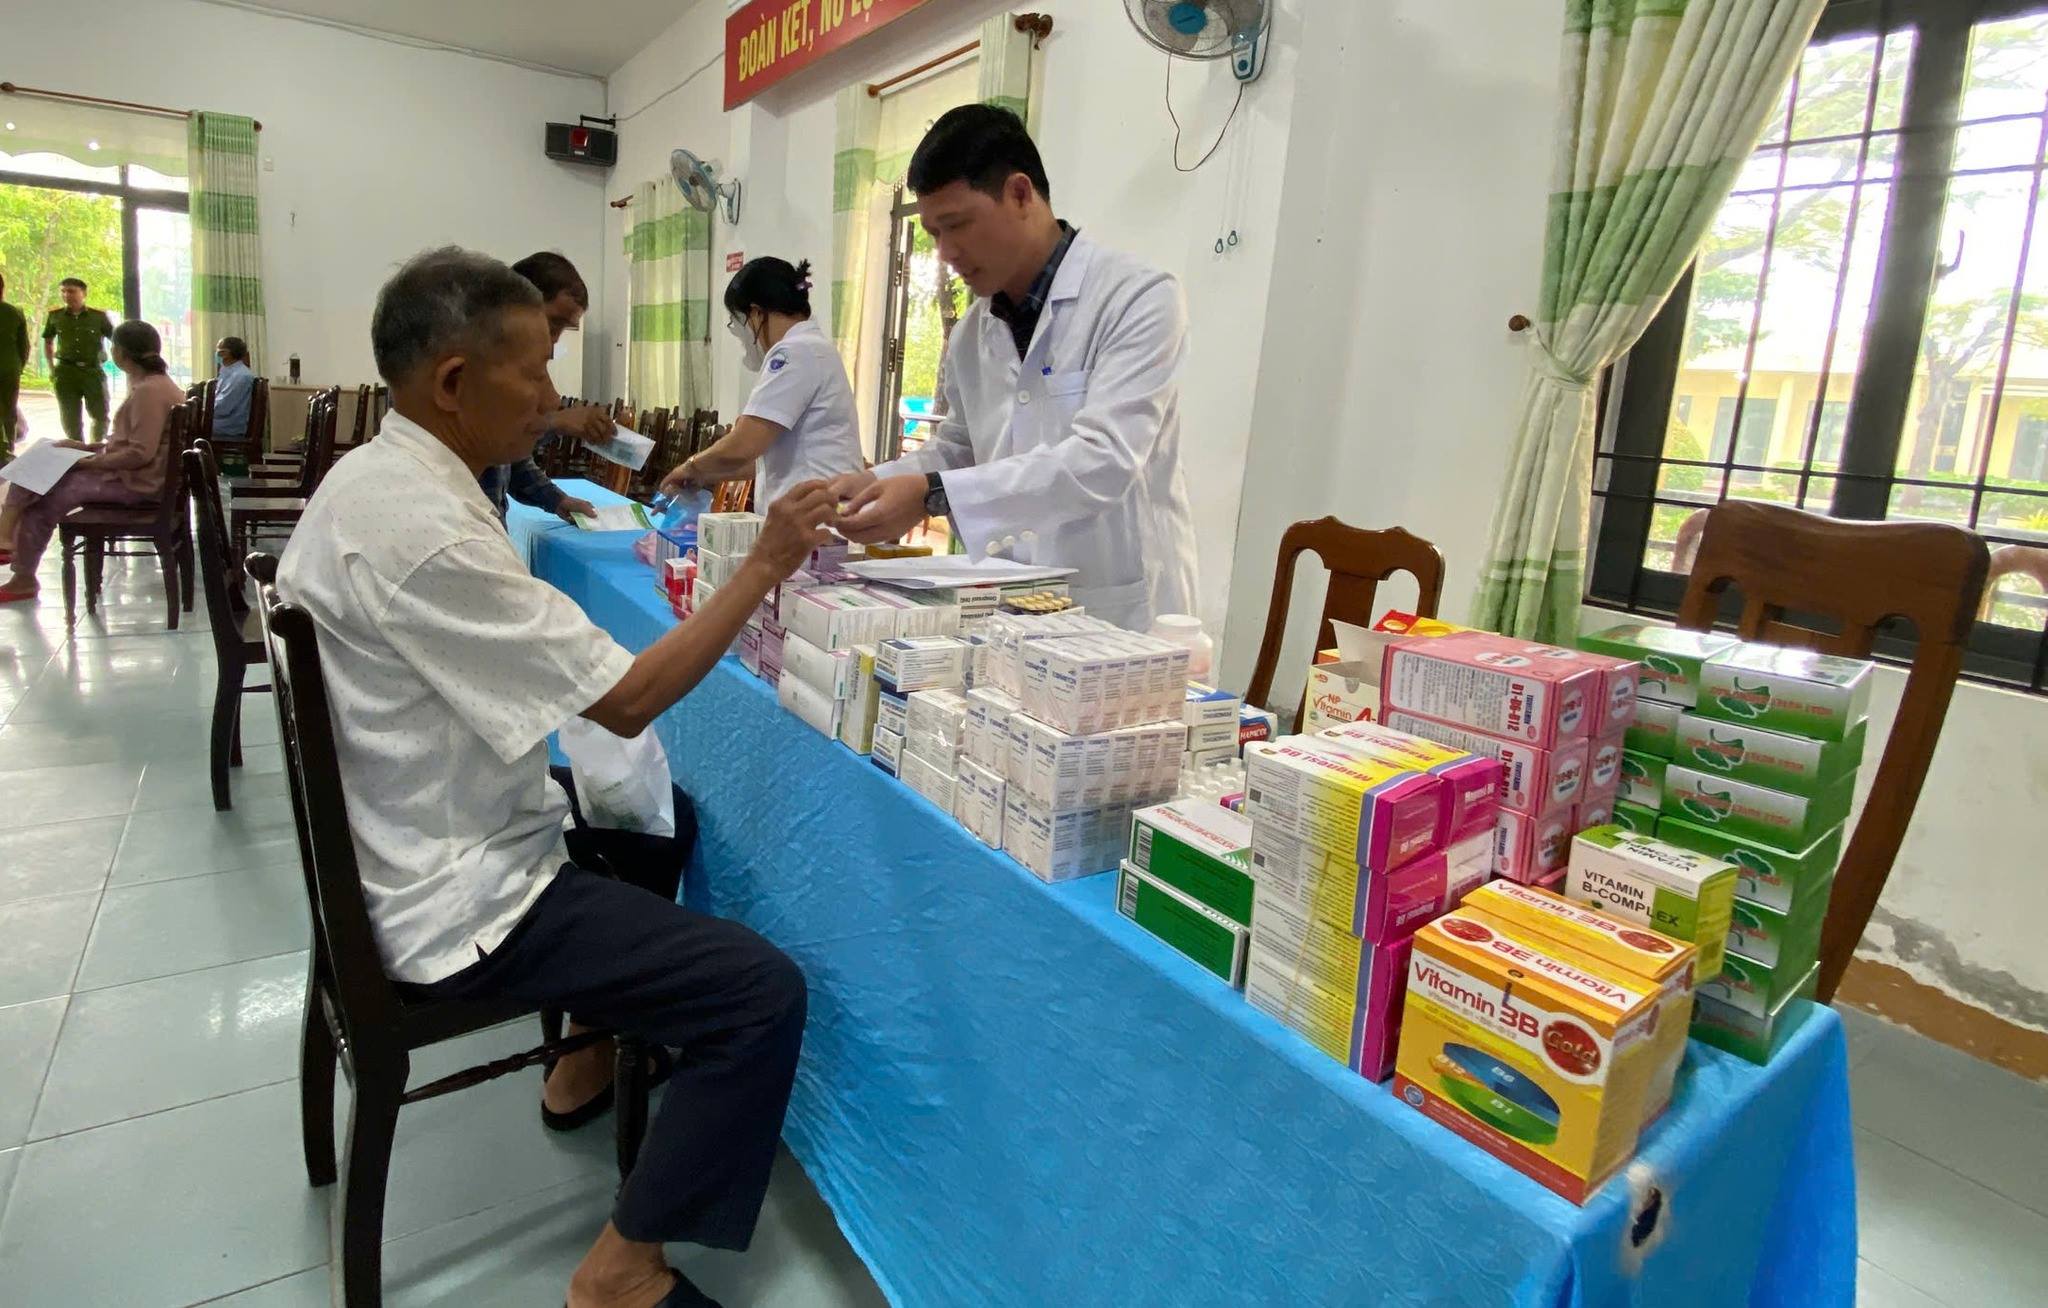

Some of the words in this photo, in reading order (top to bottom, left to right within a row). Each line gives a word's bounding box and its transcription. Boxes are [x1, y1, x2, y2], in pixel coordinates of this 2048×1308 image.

[739, 13, 777, 82] ĐOÀN
[1313, 695, 1352, 719] Vitamin
[1327, 693, 1342, 705] NP
[1303, 754, 1373, 782] Magnesi
[1585, 868, 1644, 900] VITAMIN
[1498, 883, 1575, 916] Vitamin
[1575, 912, 1618, 933] 3B
[1582, 881, 1680, 927] B-COMPLEX
[1491, 940, 1537, 963] 3B
[1535, 957, 1627, 1004] Vitamin
[1414, 962, 1495, 1018] Vitamin
[1499, 1002, 1540, 1039] 3B
[1547, 1028, 1598, 1066] Gold
[1491, 1066, 1516, 1083] B6
[1490, 1099, 1513, 1114] B1
